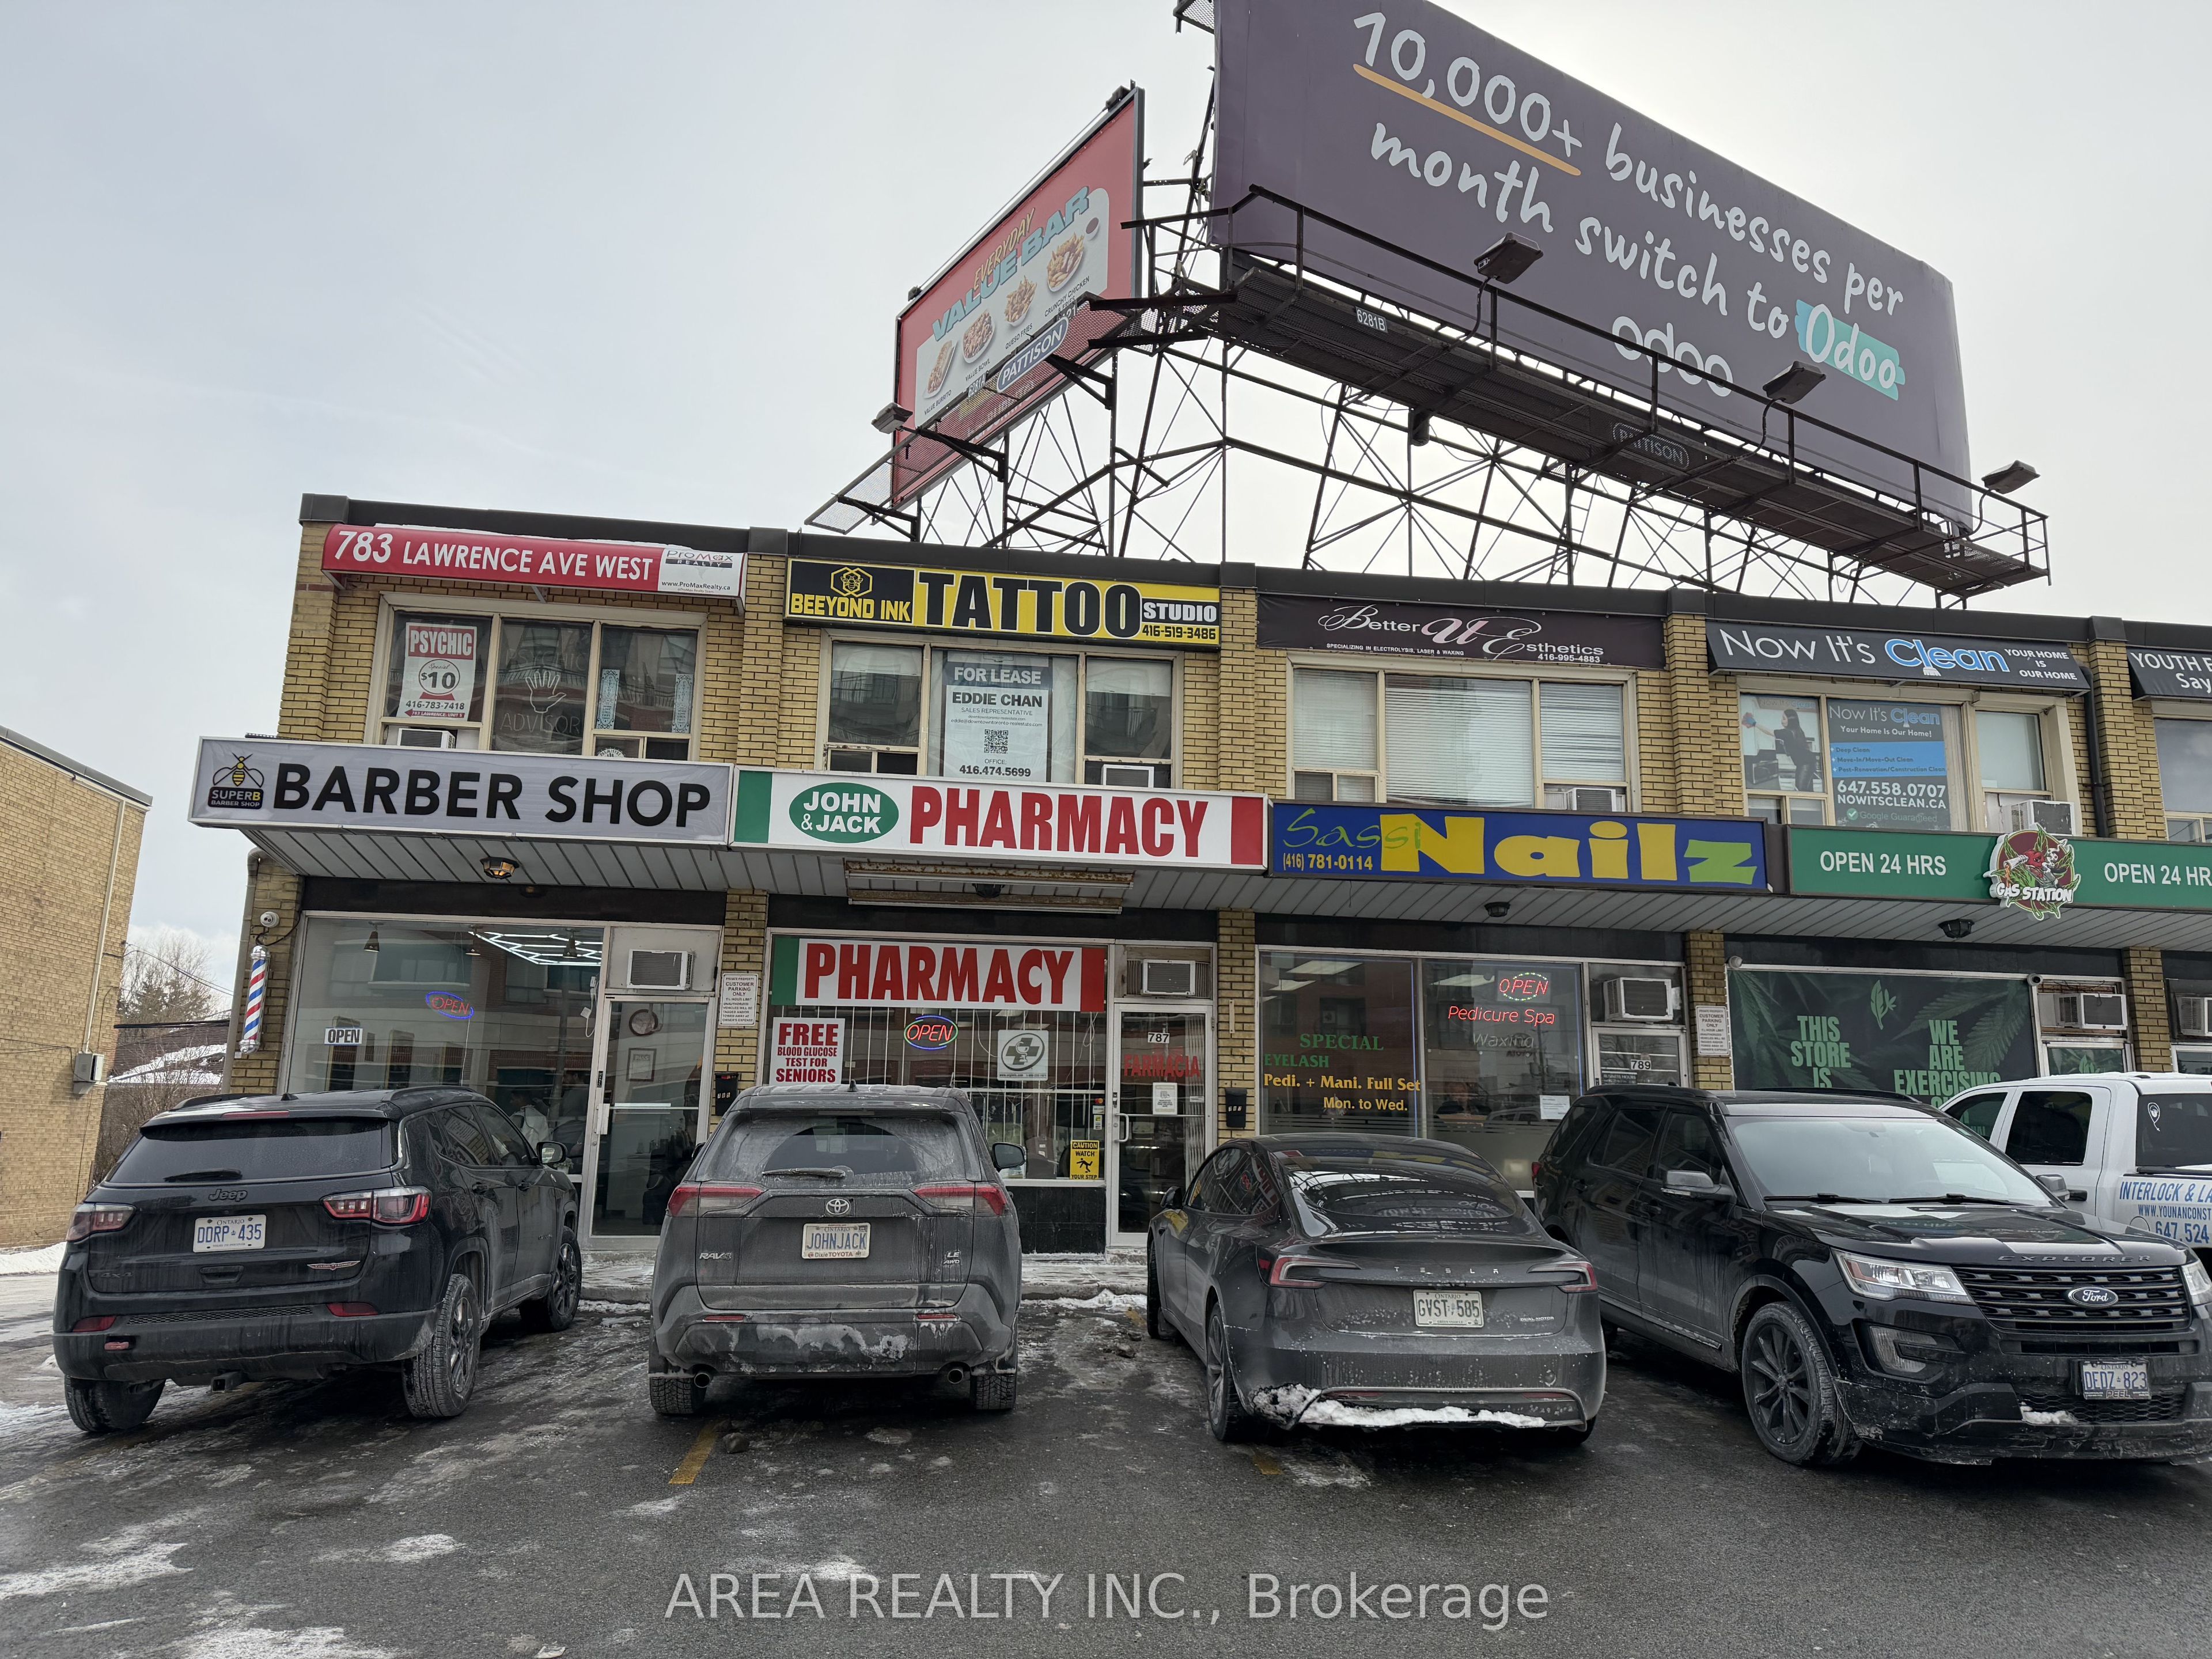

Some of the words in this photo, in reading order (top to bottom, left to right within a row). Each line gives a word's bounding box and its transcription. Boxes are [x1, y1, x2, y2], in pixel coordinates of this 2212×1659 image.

[1354, 12, 1582, 157] 10,000+
[1606, 122, 1831, 283] businesses
[1844, 263, 1903, 315] per
[974, 208, 1035, 290] EVERYDAY
[1371, 123, 1554, 232] month
[1575, 217, 1728, 316] switch
[1747, 282, 1789, 338] to
[1806, 304, 1896, 389] Odoo
[932, 250, 1018, 342] VALUE
[1021, 185, 1089, 267] BAR
[1044, 294, 1067, 317] CRUNCHY
[1357, 309, 1385, 331] 6281B
[1001, 324, 1063, 385] PATTISON
[334, 530, 393, 563] 783
[403, 541, 531, 573] LAWRENCE
[539, 551, 589, 577] AVE
[596, 555, 653, 581] WEST
[677, 559, 722, 567] REALTY
[661, 581, 730, 591] www.ProMaxRealty.ca
[791, 593, 874, 620] BEEYOND
[881, 600, 912, 622] INK
[918, 570, 1141, 638] TATTOO
[1143, 602, 1217, 623] STUDIO
[1142, 626, 1217, 641] 416-519-3486
[410, 630, 472, 656] PSYCHIC
[1537, 653, 1601, 663] 416-995-4883
[1885, 638, 2010, 674] Clean
[2004, 649, 2035, 658] YOUR
[2035, 650, 2070, 660] HOME
[2131, 652, 2203, 672] YOUTH
[954, 666, 987, 681] FOR
[991, 669, 1041, 684] LEASE
[2019, 669, 2044, 679] OUR
[2045, 671, 2078, 680] HOME
[406, 700, 465, 710] 416-783-7418
[952, 692, 997, 705] EDDIE
[1001, 694, 1042, 707] CHAN
[500, 712, 580, 734] ADVISOR
[1890, 708, 1940, 725] Clean
[959, 765, 1031, 777] 416.474.5699
[212, 790, 261, 801] SUPERB
[273, 762, 522, 820] BARBER
[544, 775, 711, 828] SHOP
[1838, 780, 1946, 798] 647.558.0707
[803, 791, 881, 813] JOHN
[1838, 795, 1946, 809] NOWITSCLEAN.CA
[801, 813, 814, 831] &
[815, 815, 882, 834] JACK
[910, 785, 1209, 857] PHARMACY
[1859, 811, 1889, 820] Google
[1891, 812, 1937, 822] Guaranteed
[1380, 813, 1758, 885] Nailz
[1282, 852, 1304, 872] (416)
[1307, 853, 1373, 871] 781-0114
[1819, 850, 1876, 874] OPEN
[1880, 853, 1902, 874] 24
[1906, 854, 1947, 876] HRS
[2104, 862, 2156, 885] OPEN
[2160, 865, 2181, 886] 24
[1997, 883, 2021, 897] GAS
[2022, 886, 2073, 902] STATION
[804, 943, 1074, 1005] PHARMACY
[1499, 978, 1549, 995] OPEN
[433, 997, 469, 1015] OPEN
[1448, 1006, 1519, 1022] Pedicure
[1524, 1009, 1555, 1027] Spa
[328, 1029, 361, 1043] OPEN
[778, 1022, 839, 1046] FREE
[907, 1024, 954, 1041] OPEN
[1797, 1015, 1841, 1042] THIS
[1928, 1019, 1959, 1045] WE
[1148, 1033, 1169, 1043] 787
[1300, 1033, 1384, 1051] SPECIAL
[777, 1046, 802, 1056] BLOOD
[804, 1047, 838, 1057] GLUCOSE
[1790, 1040, 1852, 1068] STORE
[1929, 1044, 1965, 1071] ARE
[785, 1058, 808, 1067] TEST
[810, 1058, 828, 1067] FOR
[1124, 1054, 1201, 1077] FARMACIA
[1264, 1053, 1330, 1069] EYELASH
[1631, 1060, 1651, 1070] 789
[776, 1068, 836, 1083] SENIORS
[1264, 1073, 1300, 1087] Pedi.
[1320, 1075, 1362, 1089] Mani.
[1367, 1077, 1393, 1090] Full
[1397, 1078, 1421, 1091] Set
[1813, 1067, 1832, 1088] IS
[1324, 1097, 1355, 1109] Mon.
[1358, 1099, 1372, 1110] to
[1376, 1099, 1408, 1111] Wed.
[209, 1189, 248, 1202] Jeep
[2119, 1181, 2184, 1202] INTERLOCK
[2184, 1183, 2196, 1202] &
[238, 1224, 262, 1241] 435
[806, 1233, 867, 1249] JOHNJACK
[1393, 1266, 1499, 1274] TESLA
[2082, 1289, 2109, 1302] Ford
[1456, 1300, 1480, 1318] 585
[2105, 1389, 2131, 1399] PEEL
